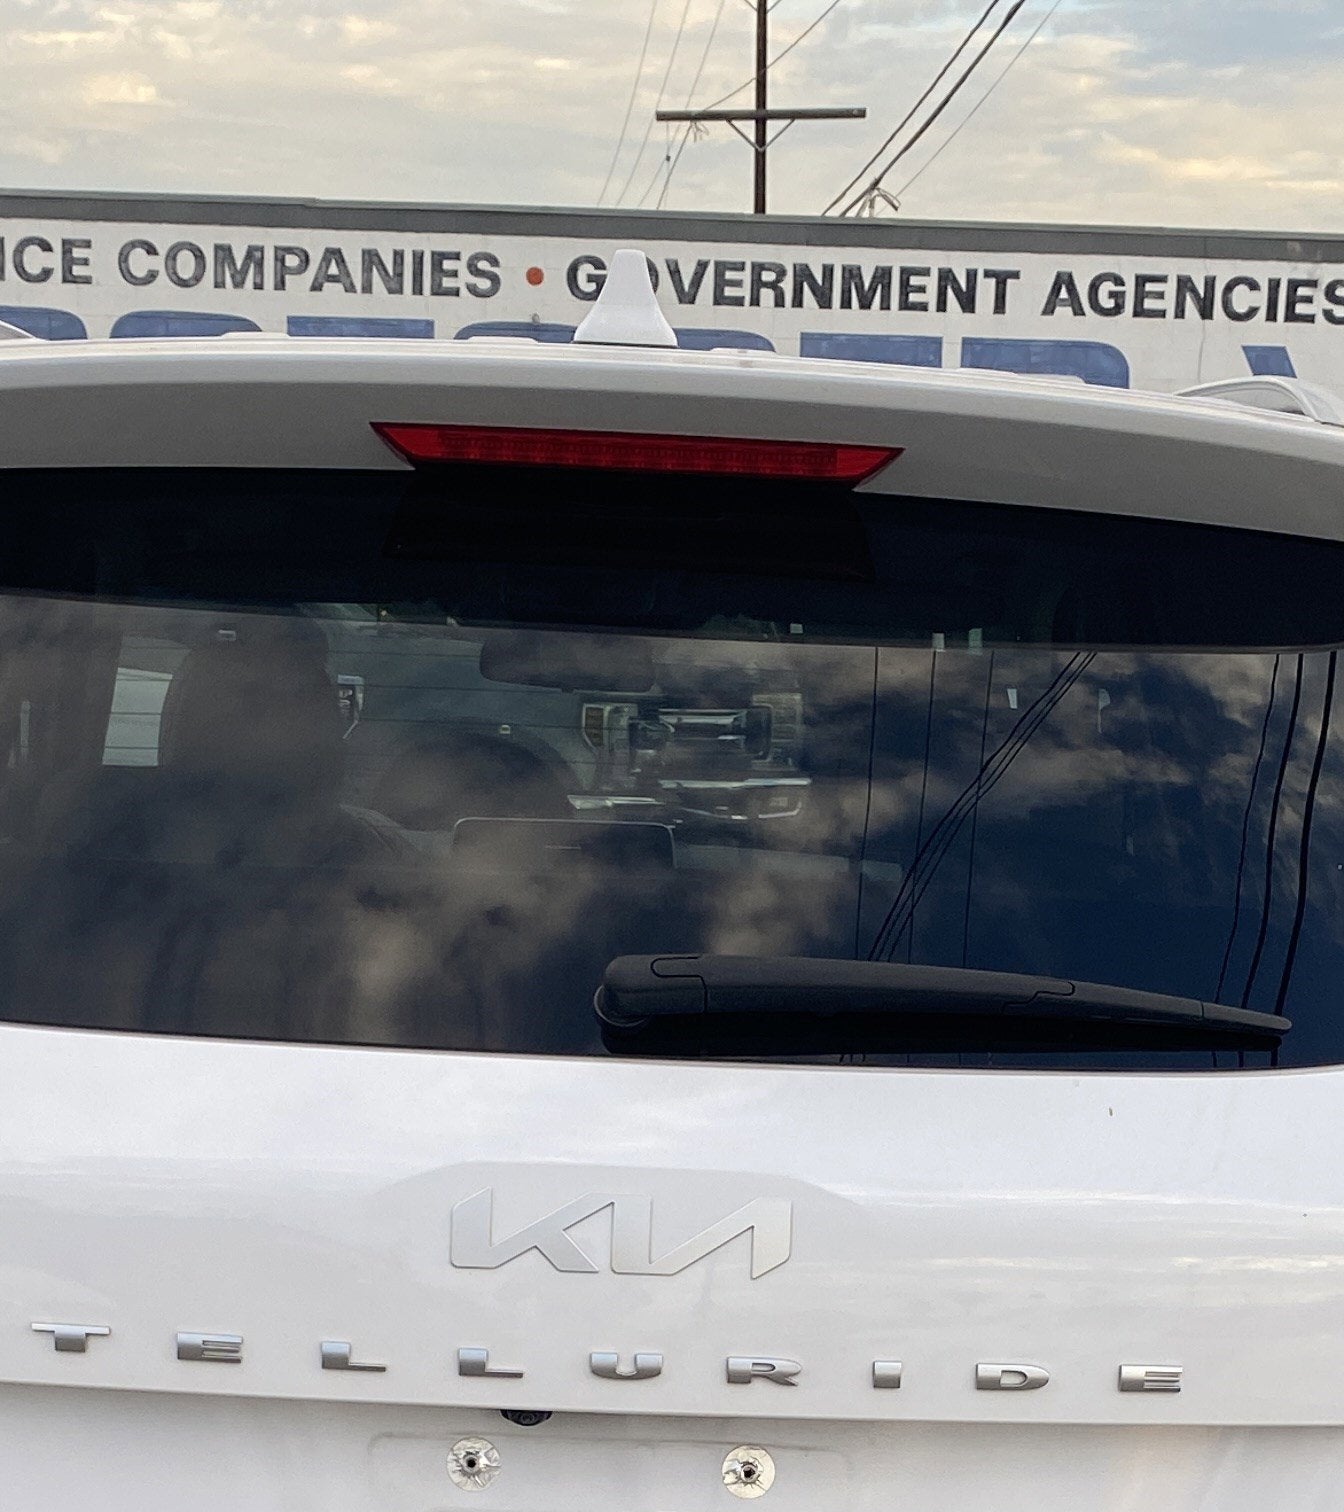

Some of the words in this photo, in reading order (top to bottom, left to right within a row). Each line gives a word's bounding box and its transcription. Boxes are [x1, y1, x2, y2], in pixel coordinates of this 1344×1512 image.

[117, 238, 502, 299] COMPANIES
[566, 254, 1022, 317] GVERNMENT
[449, 1186, 794, 1280] KIA
[30, 1320, 1184, 1396] TELLURIDE
